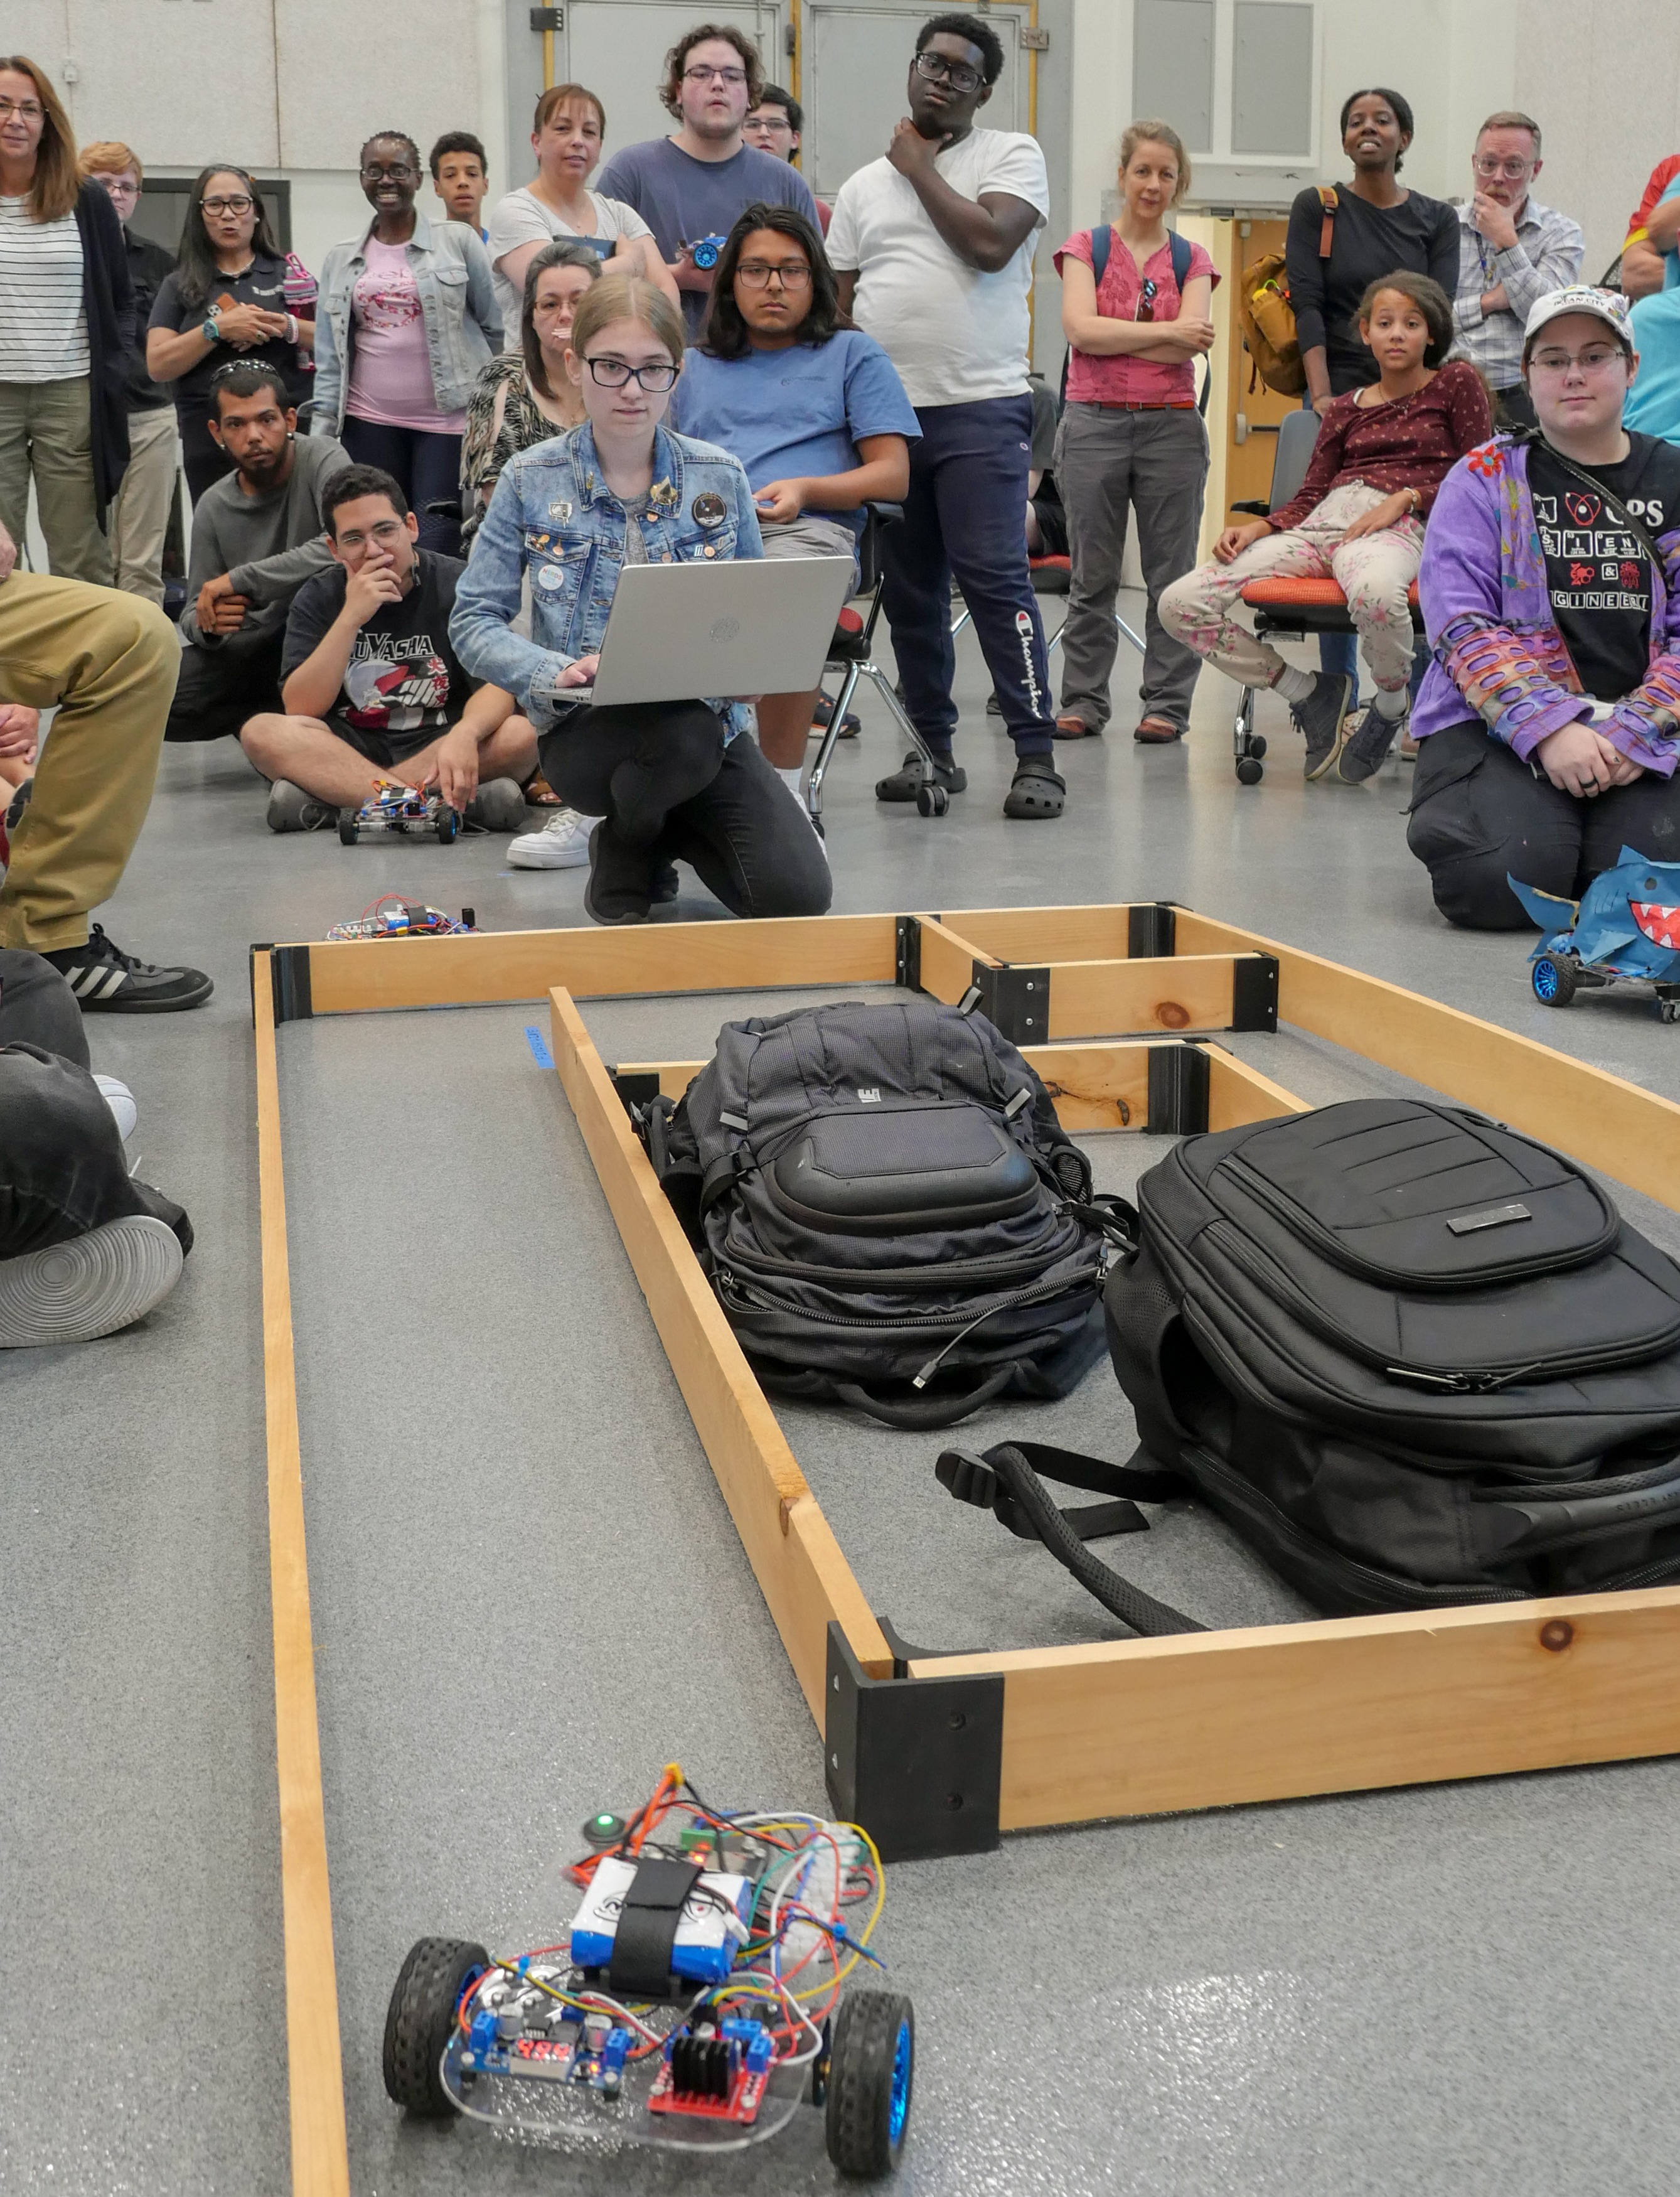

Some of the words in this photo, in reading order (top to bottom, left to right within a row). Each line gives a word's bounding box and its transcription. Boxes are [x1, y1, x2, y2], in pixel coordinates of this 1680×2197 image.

[1556, 594, 1647, 610] GINEERI
[350, 633, 437, 661] UYASHA
[1015, 610, 1043, 719] Champion
